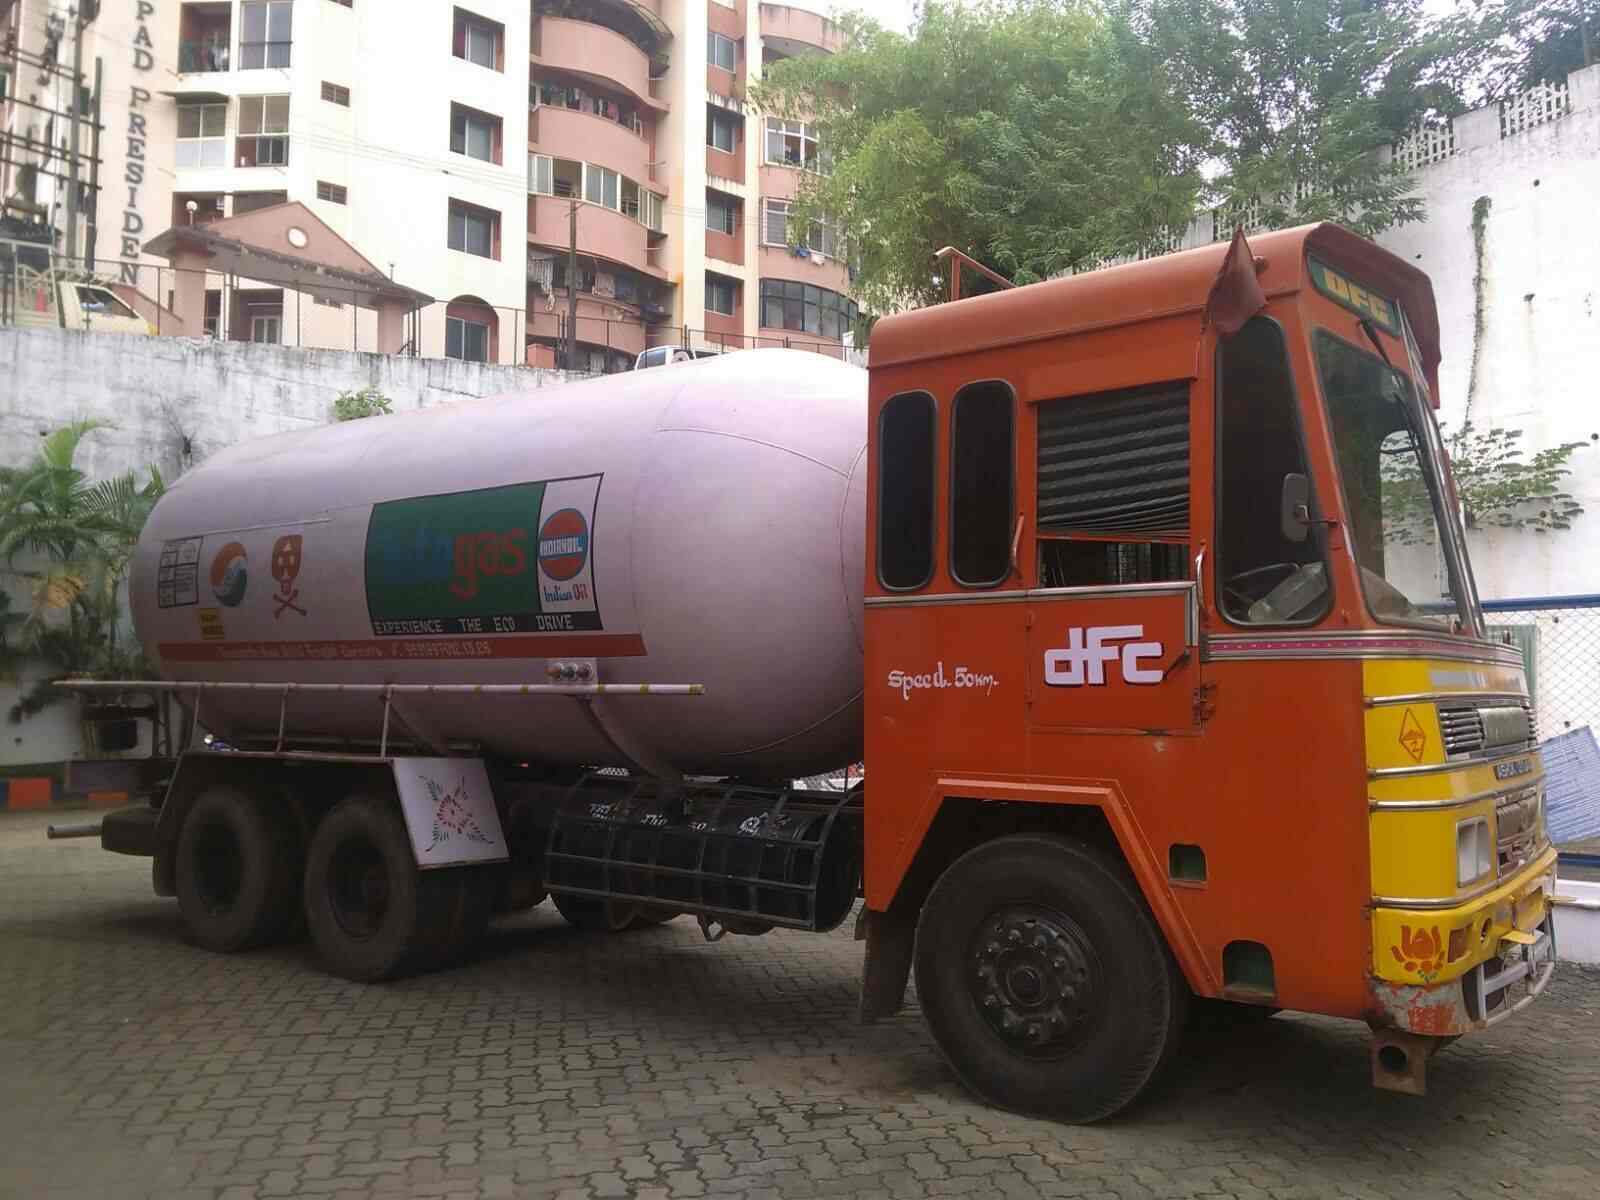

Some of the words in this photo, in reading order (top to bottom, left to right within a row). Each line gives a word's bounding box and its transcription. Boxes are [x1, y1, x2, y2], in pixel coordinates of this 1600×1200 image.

[373, 619, 444, 635] EXPERIENCE
[457, 617, 483, 632] THE
[493, 616, 516, 631] ECO
[535, 614, 575, 630] DRIVE
